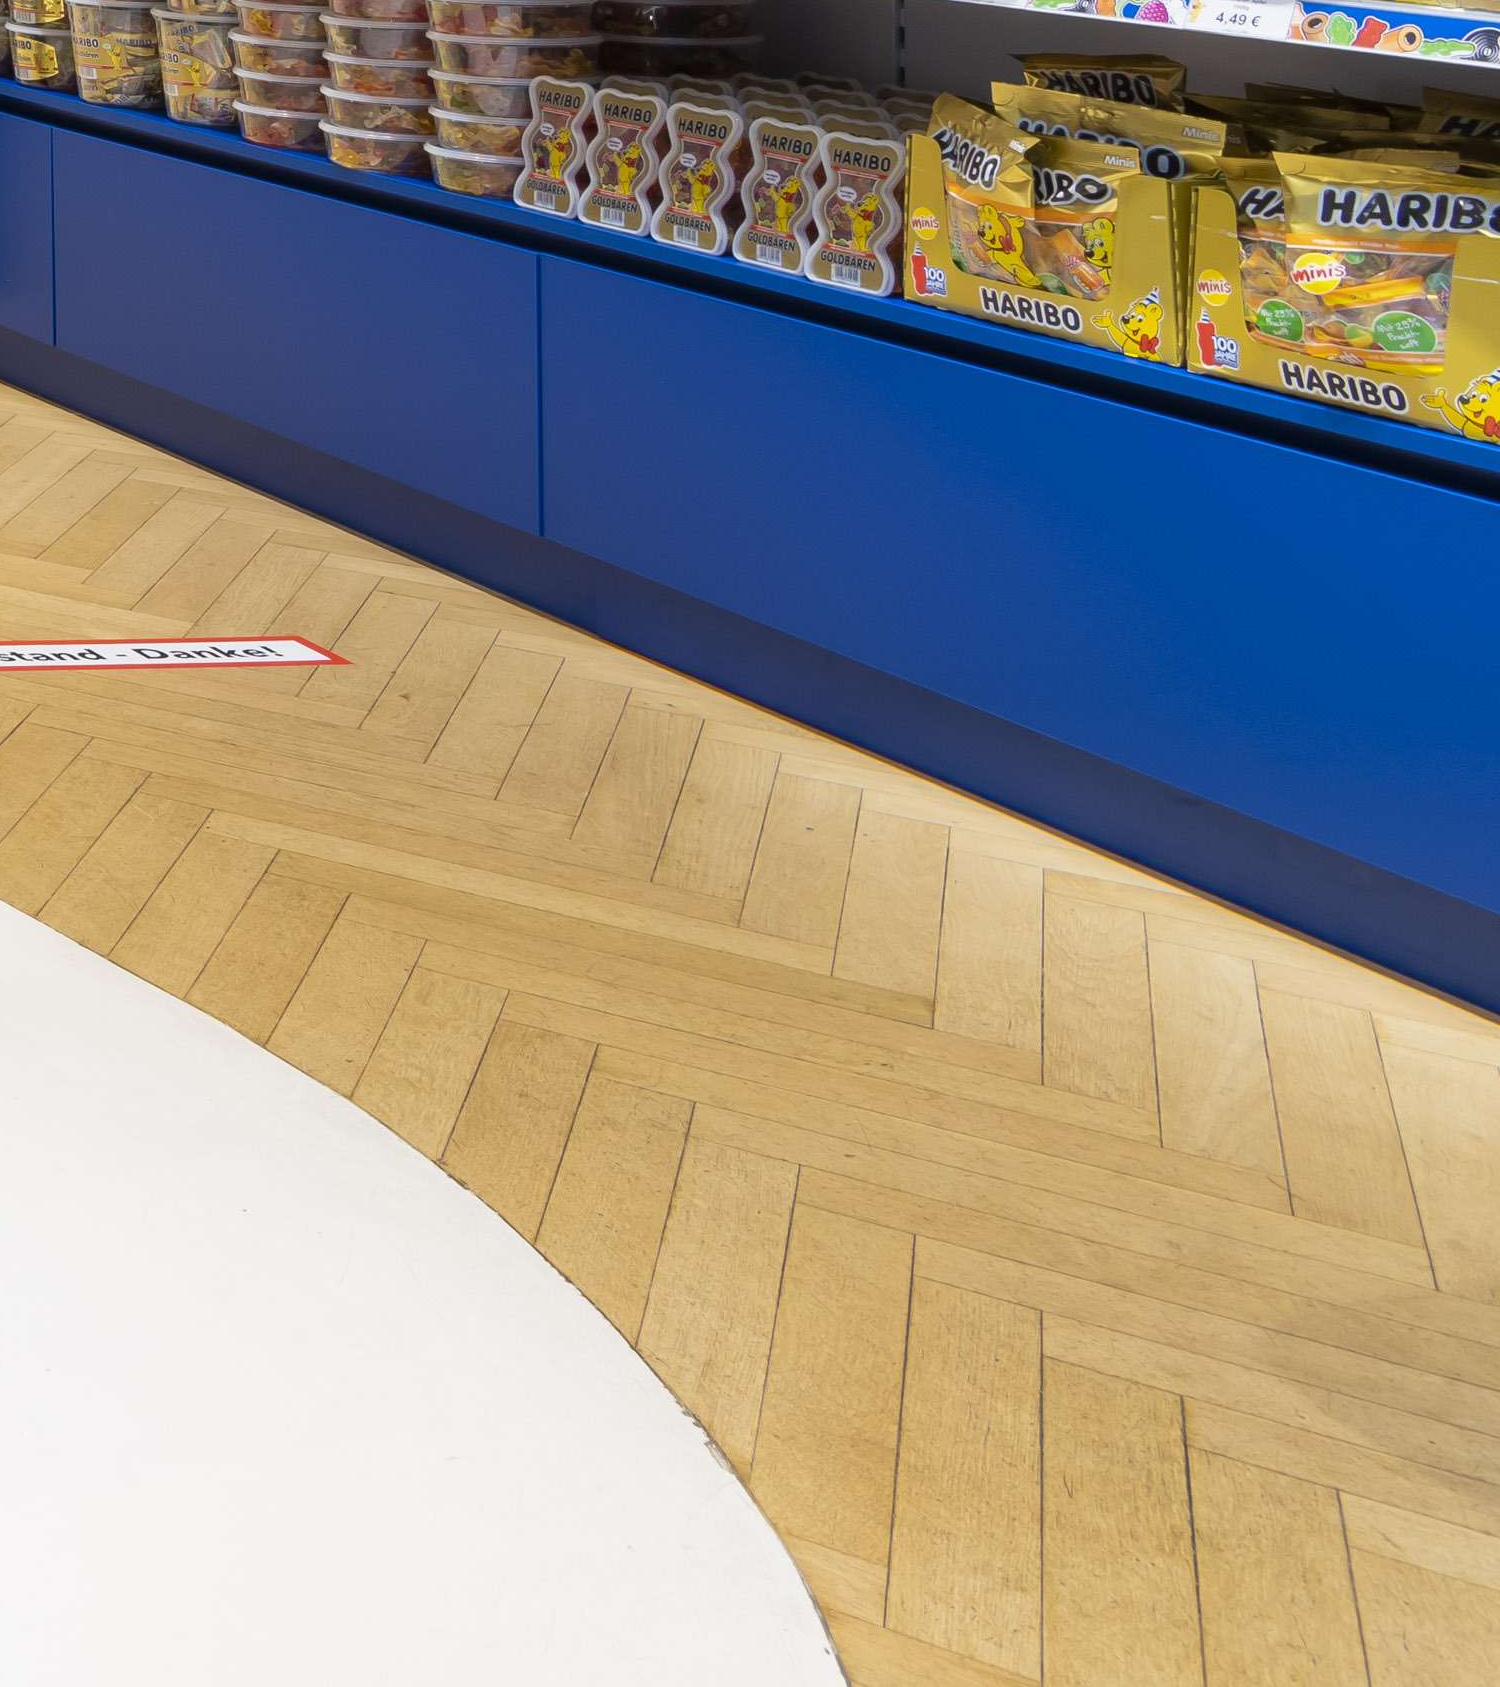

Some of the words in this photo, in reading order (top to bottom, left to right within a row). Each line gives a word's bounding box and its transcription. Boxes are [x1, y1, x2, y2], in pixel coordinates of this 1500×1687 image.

[1217, 12, 1247, 26] 4,49
[1252, 14, 1261, 27] €
[678, 117, 727, 140] HARIBO
[833, 148, 891, 172] HARIBO
[1104, 155, 1136, 168] Minis
[911, 216, 940, 229] minis
[1292, 264, 1346, 280] minis
[982, 288, 1080, 330] HARIBO
[1283, 362, 1406, 411] HARIBO
[134, 644, 282, 660] Danke!
